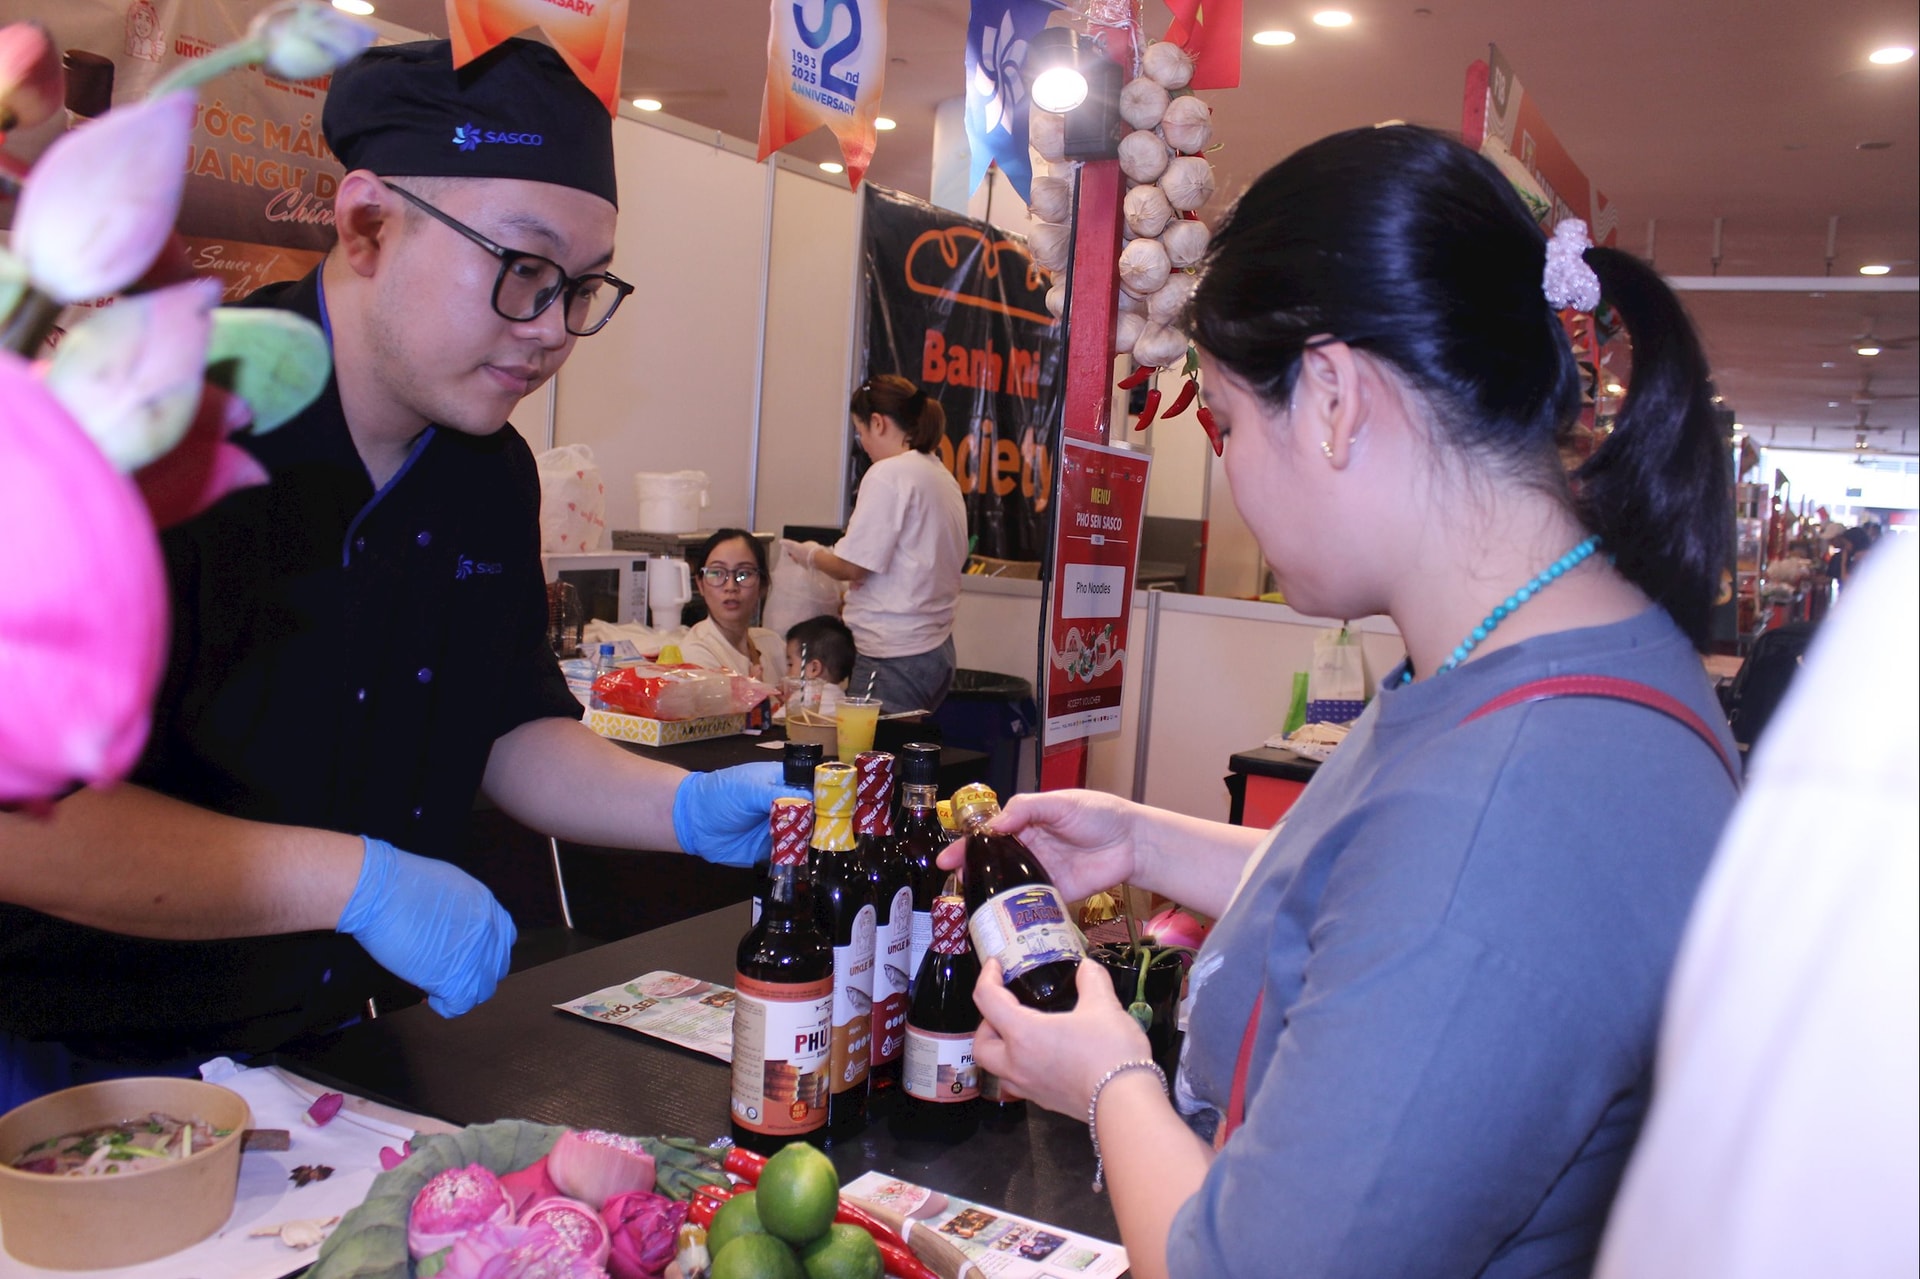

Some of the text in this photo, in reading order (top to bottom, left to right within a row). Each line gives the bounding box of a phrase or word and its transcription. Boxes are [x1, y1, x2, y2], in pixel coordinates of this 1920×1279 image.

[791, 49, 817, 69] 1993
[791, 65, 817, 84] 2025
[791, 82, 856, 116] ANNIVERSARY
[484, 131, 543, 146] SASCO
[192, 245, 280, 281] Sauce of
[921, 328, 1002, 393] Banh
[937, 418, 1050, 514] ociety
[1090, 487, 1112, 505] MENU
[1090, 514, 1102, 529] SEN
[1102, 516, 1123, 531] SASCO
[1076, 582, 1111, 595] Pho Noodles
[794, 1026, 828, 1054] PHÚ
